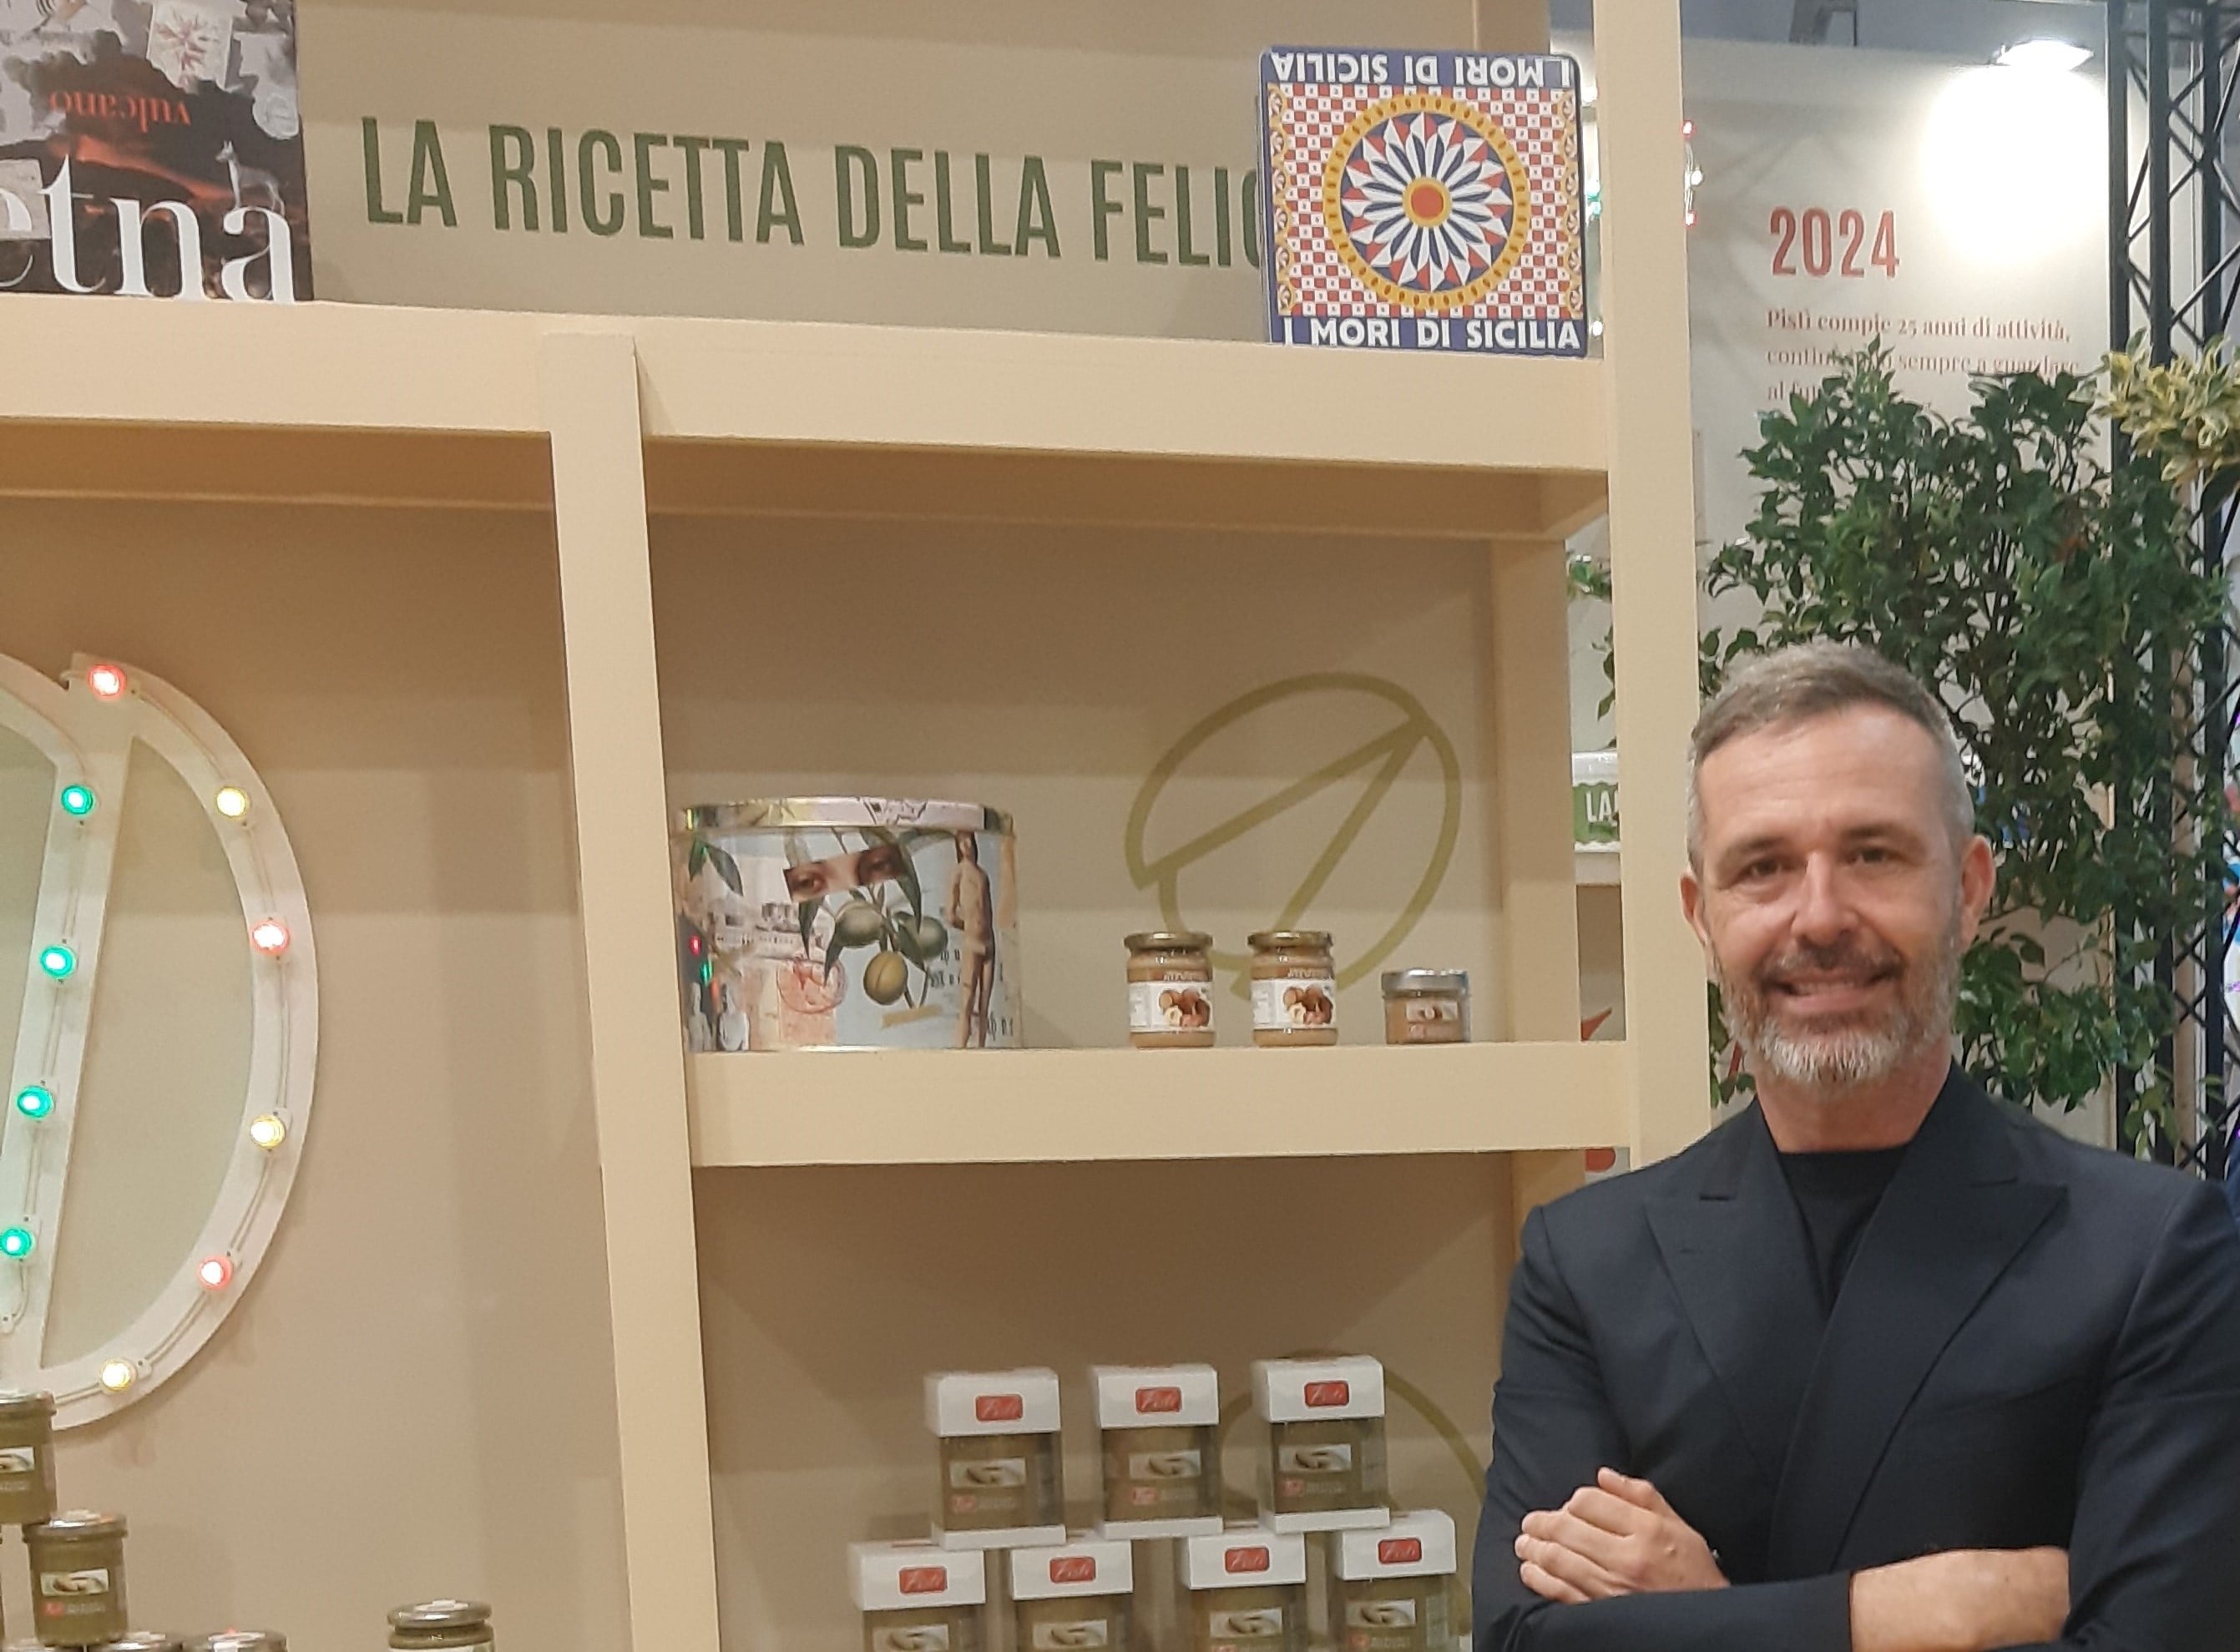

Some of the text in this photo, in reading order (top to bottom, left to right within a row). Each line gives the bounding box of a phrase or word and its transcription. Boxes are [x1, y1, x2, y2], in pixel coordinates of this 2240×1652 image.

[1270, 51, 1571, 88] I MORI DI SICILIA
[49, 91, 191, 134] vulcano
[362, 116, 458, 226] LA
[488, 124, 805, 245] RICETTA
[835, 144, 1062, 258] DELLA
[1770, 206, 1900, 277] 2024
[1283, 318, 1580, 350] I MORI DI SICILIA
[1818, 313, 1891, 336] compie
[1923, 317, 1966, 336] anni
[1973, 316, 1990, 337] di
[1899, 354, 1971, 375] sempre
